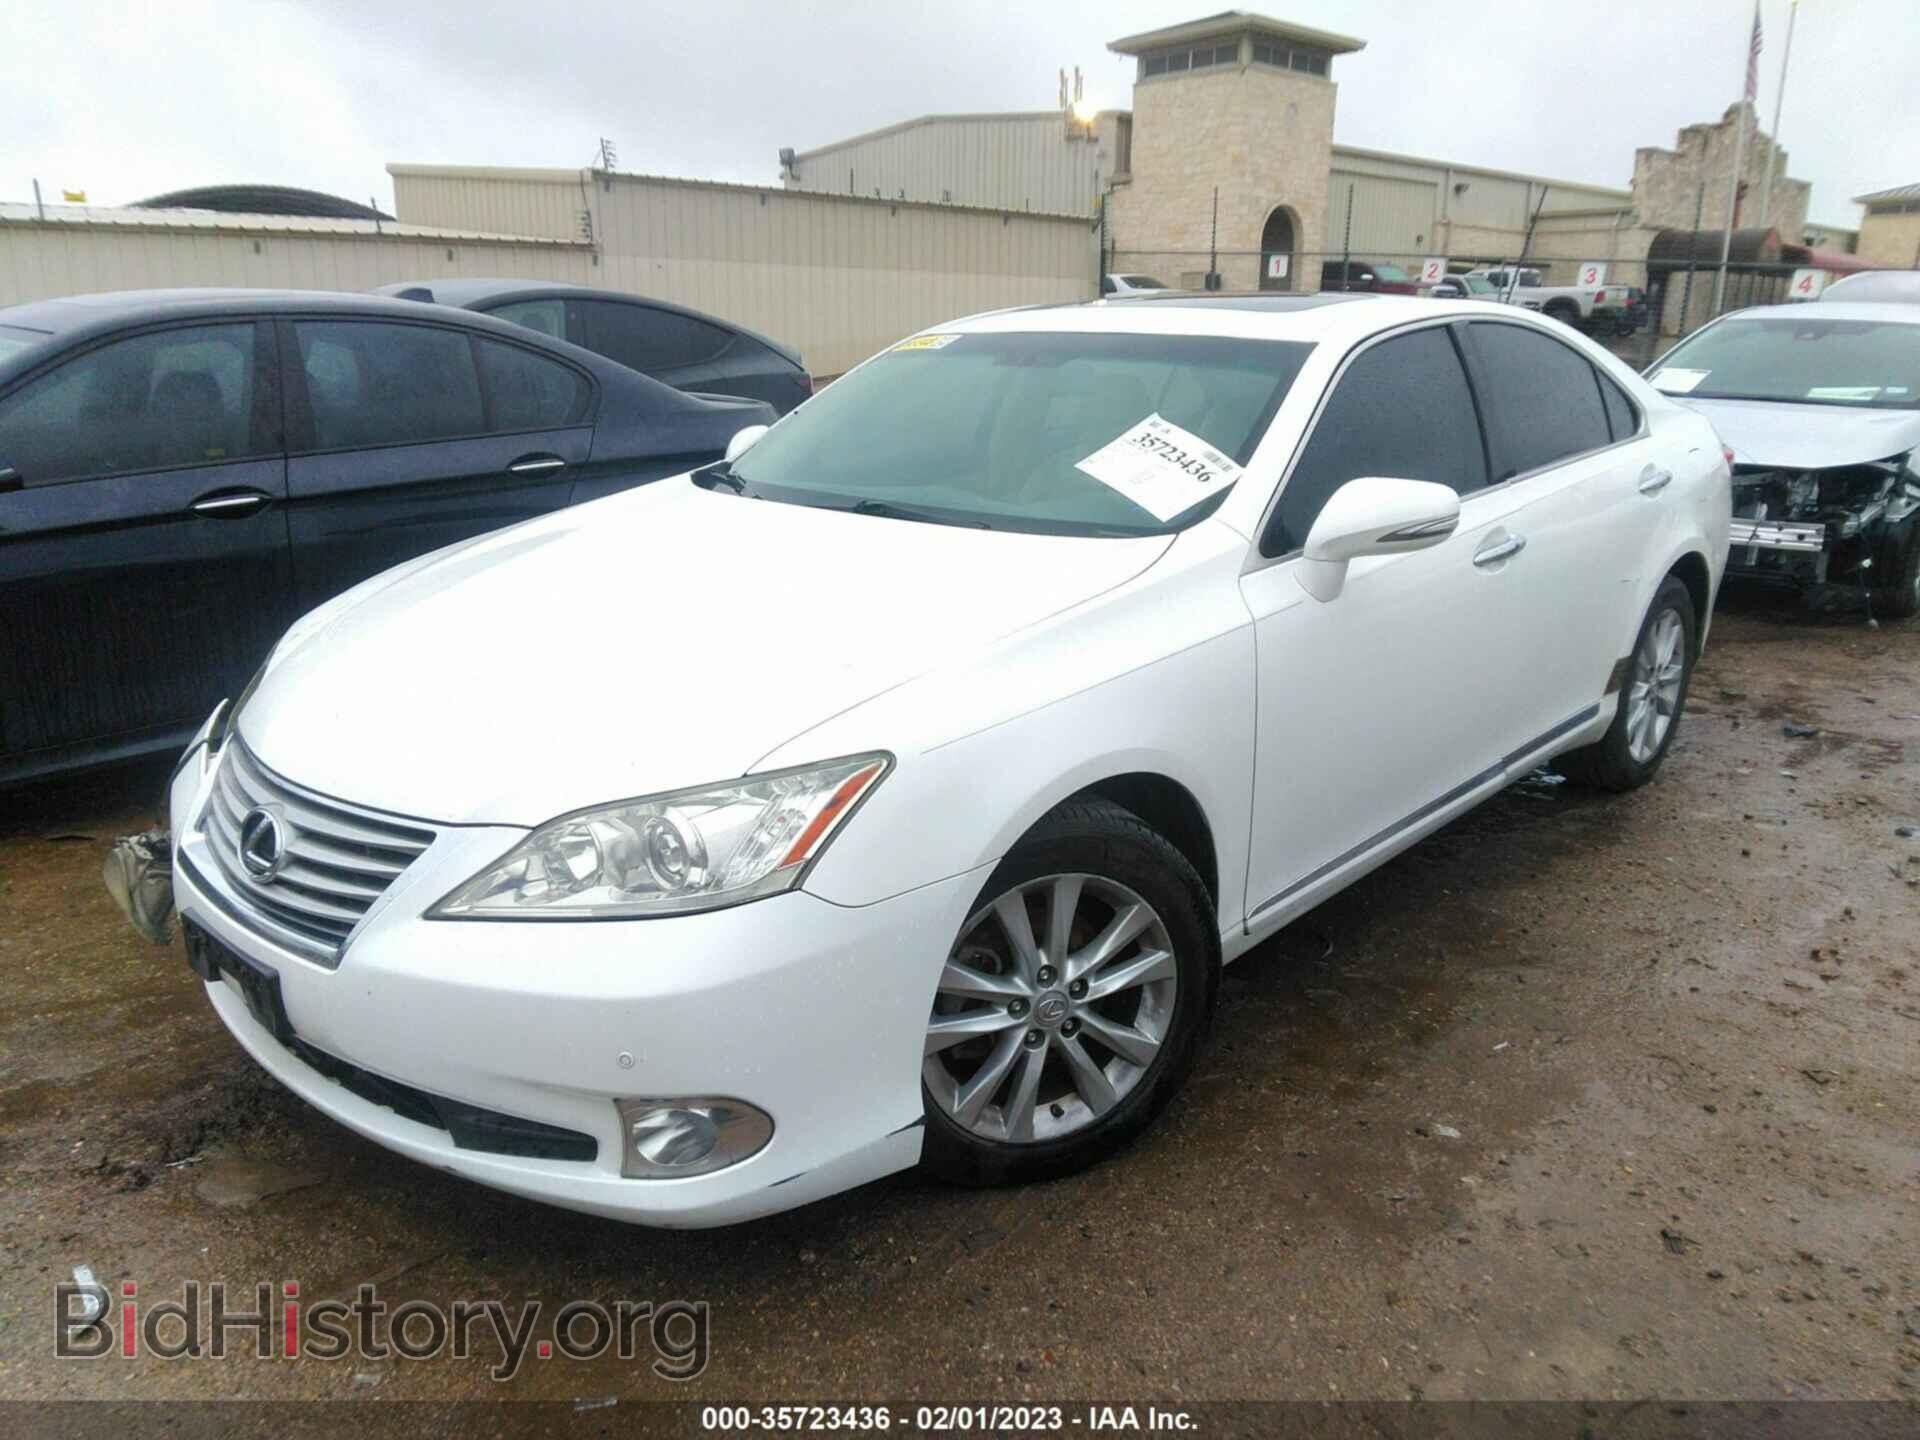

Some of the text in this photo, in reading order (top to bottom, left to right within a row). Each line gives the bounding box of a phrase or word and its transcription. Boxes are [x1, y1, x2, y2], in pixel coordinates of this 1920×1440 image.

[1273, 258, 1281, 273] 1
[1428, 263, 1439, 278] 2
[1584, 267, 1597, 284] 3
[1799, 275, 1814, 293] 4
[1132, 432, 1215, 482] 35723436
